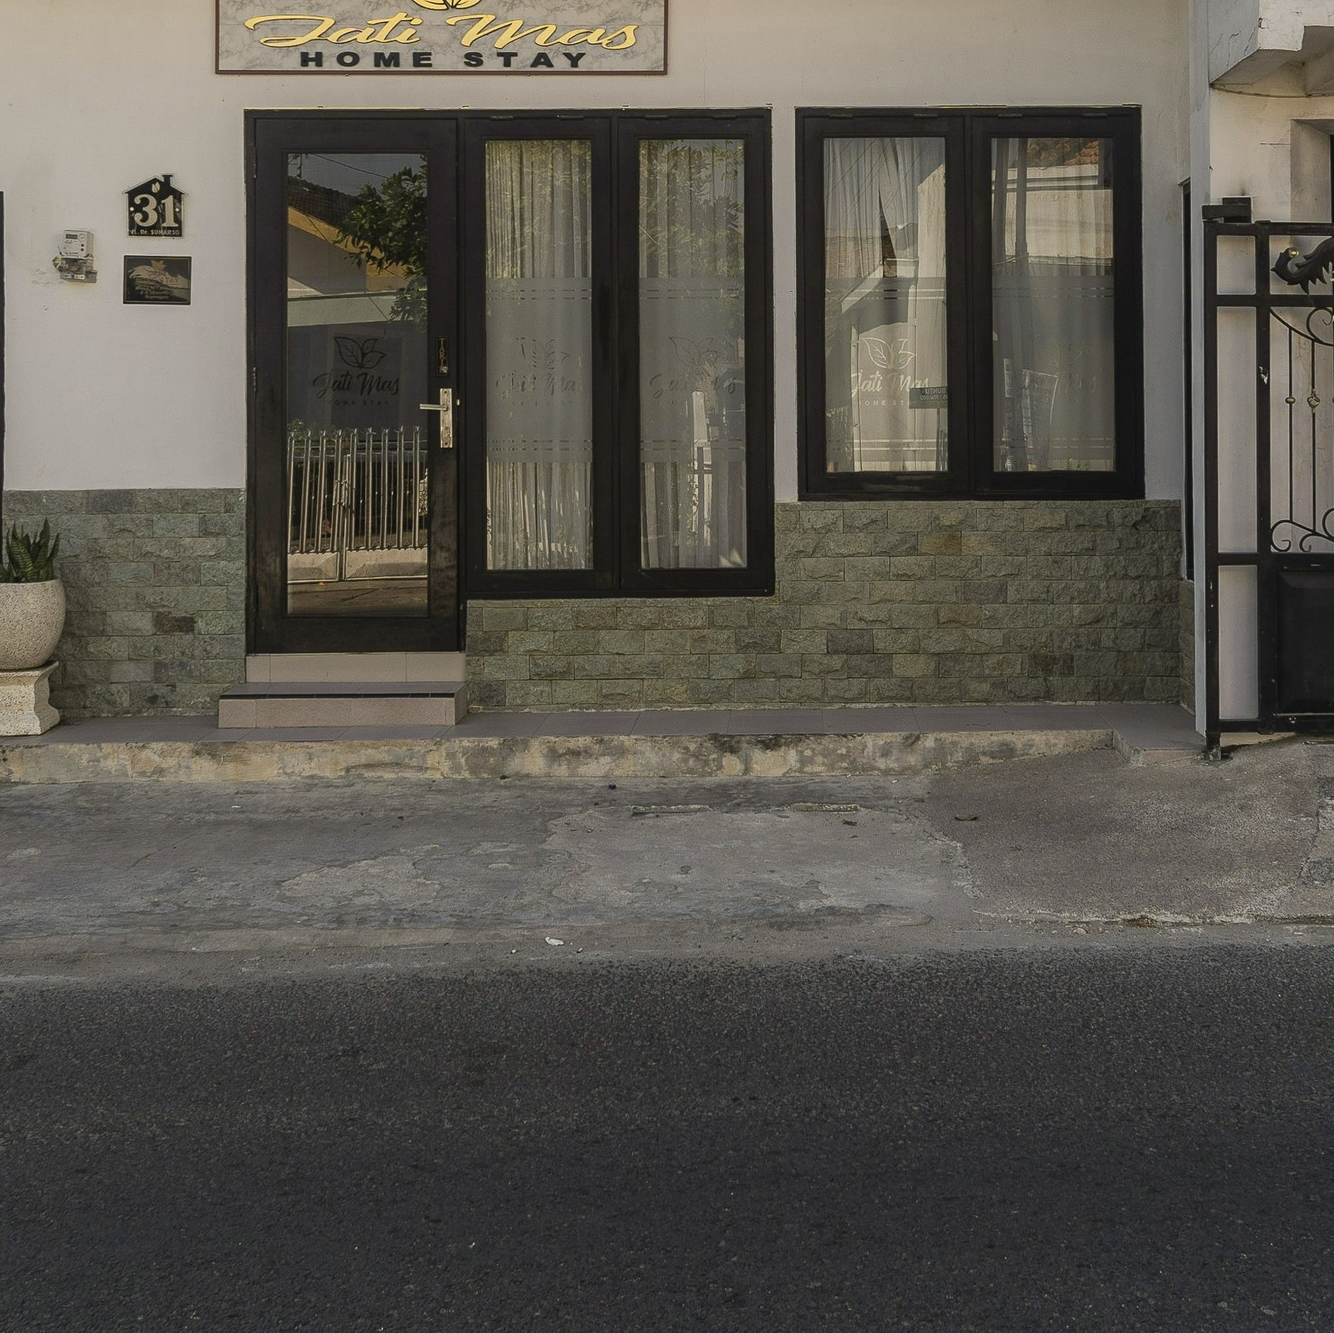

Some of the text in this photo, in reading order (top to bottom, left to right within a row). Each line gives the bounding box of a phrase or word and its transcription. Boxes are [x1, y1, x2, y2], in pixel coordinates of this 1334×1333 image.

[244, 12, 639, 51] Jati Mas
[300, 51, 586, 67] HOME STAY
[134, 194, 179, 227] 31
[312, 369, 400, 399] Jati Mas
